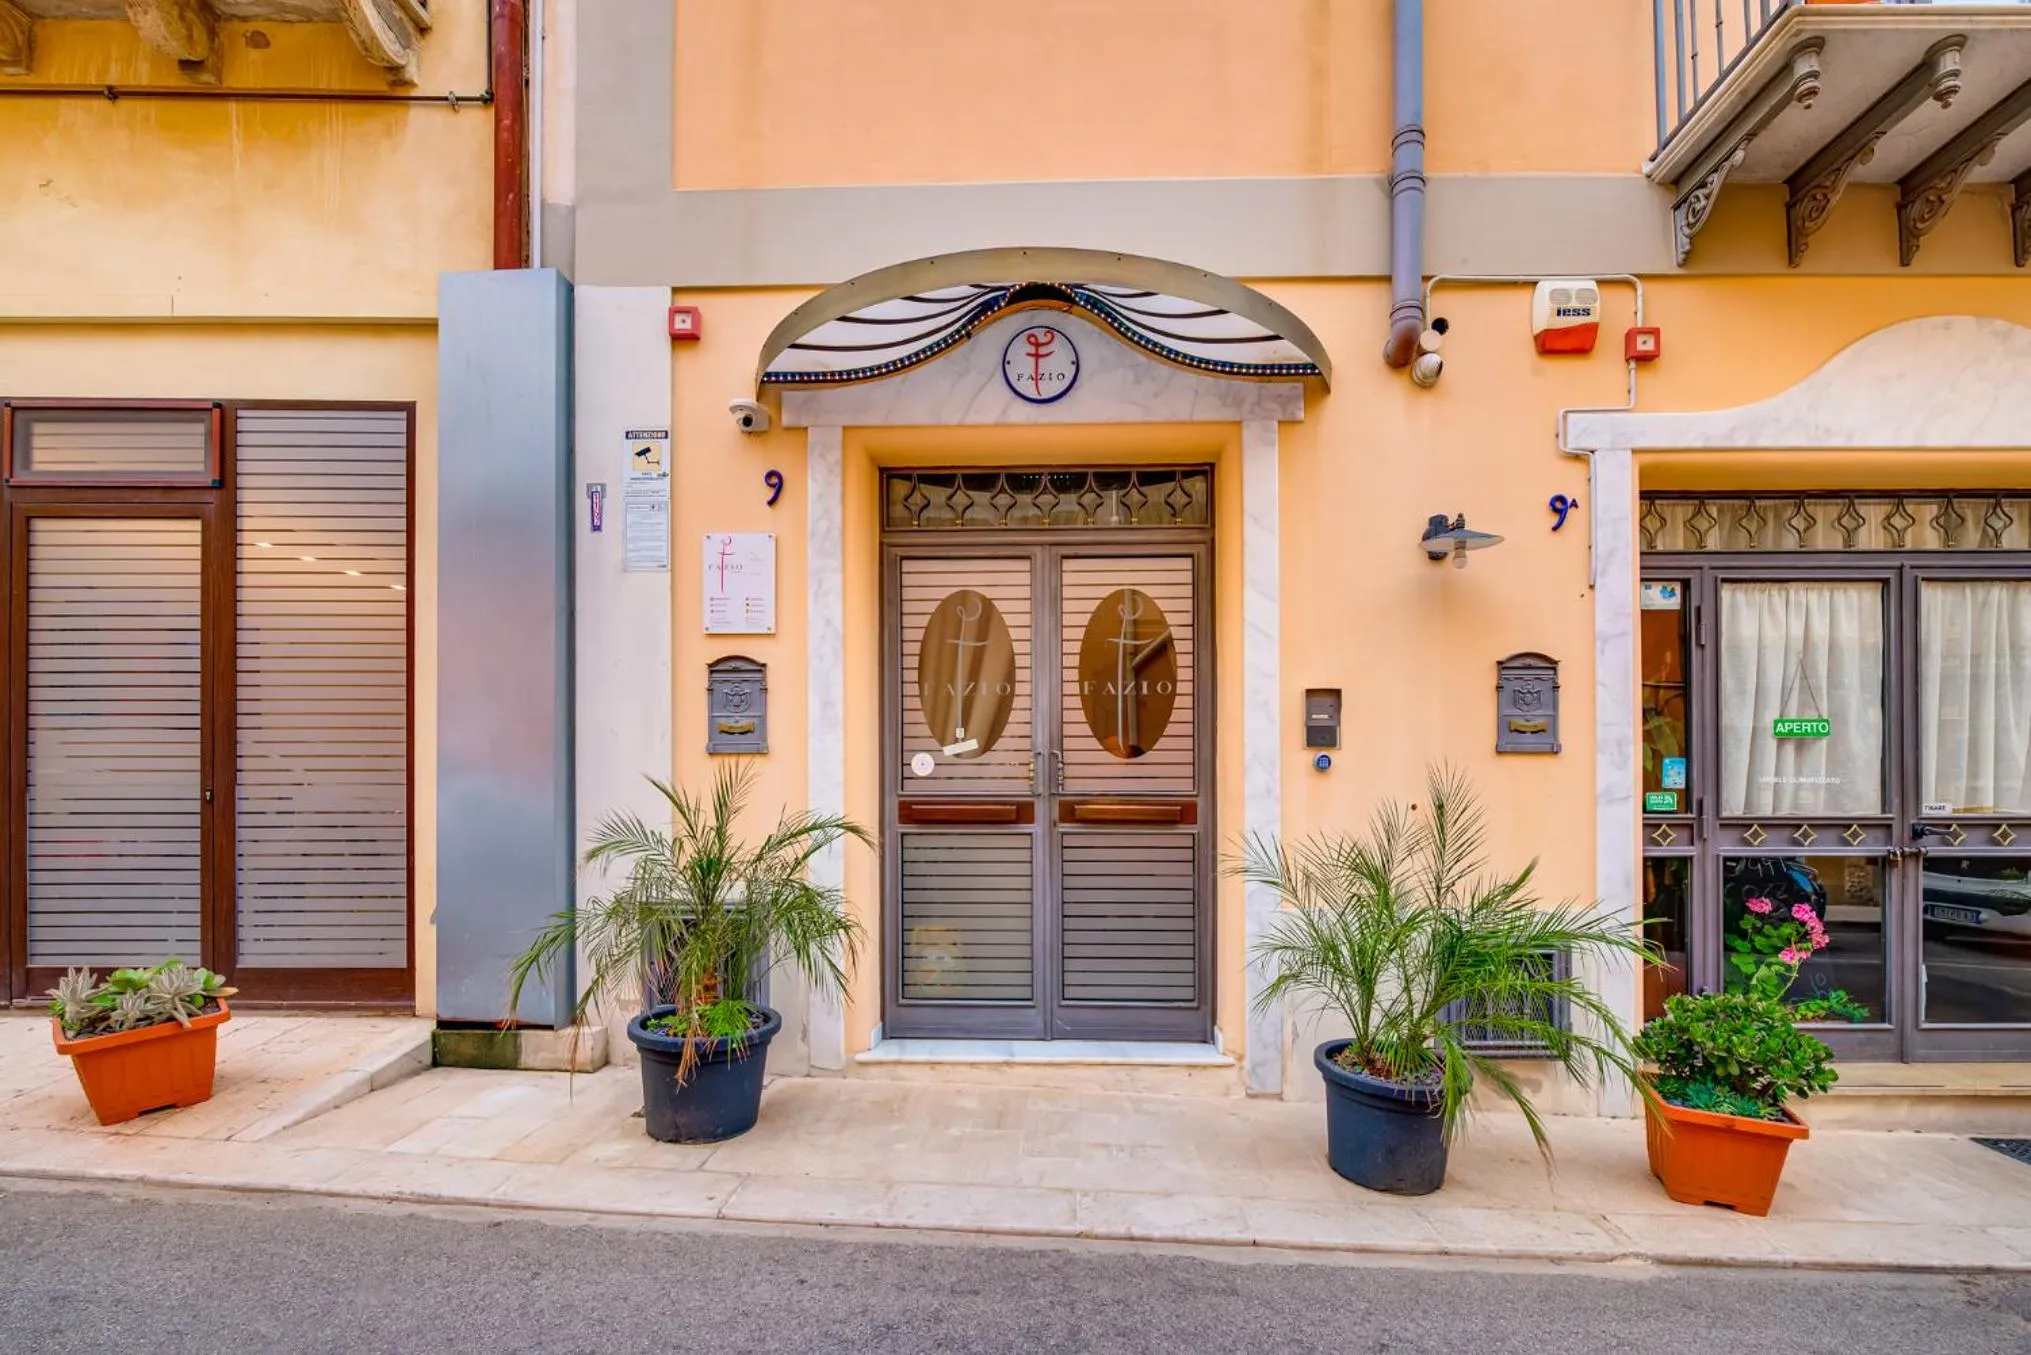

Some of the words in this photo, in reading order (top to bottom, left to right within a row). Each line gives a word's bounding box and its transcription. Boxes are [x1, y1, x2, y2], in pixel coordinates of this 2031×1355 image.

[1017, 373, 1065, 381] FAZIO
[764, 469, 784, 507] 9
[1083, 681, 1172, 695] FAZIO
[1775, 722, 1829, 733] APERTO
